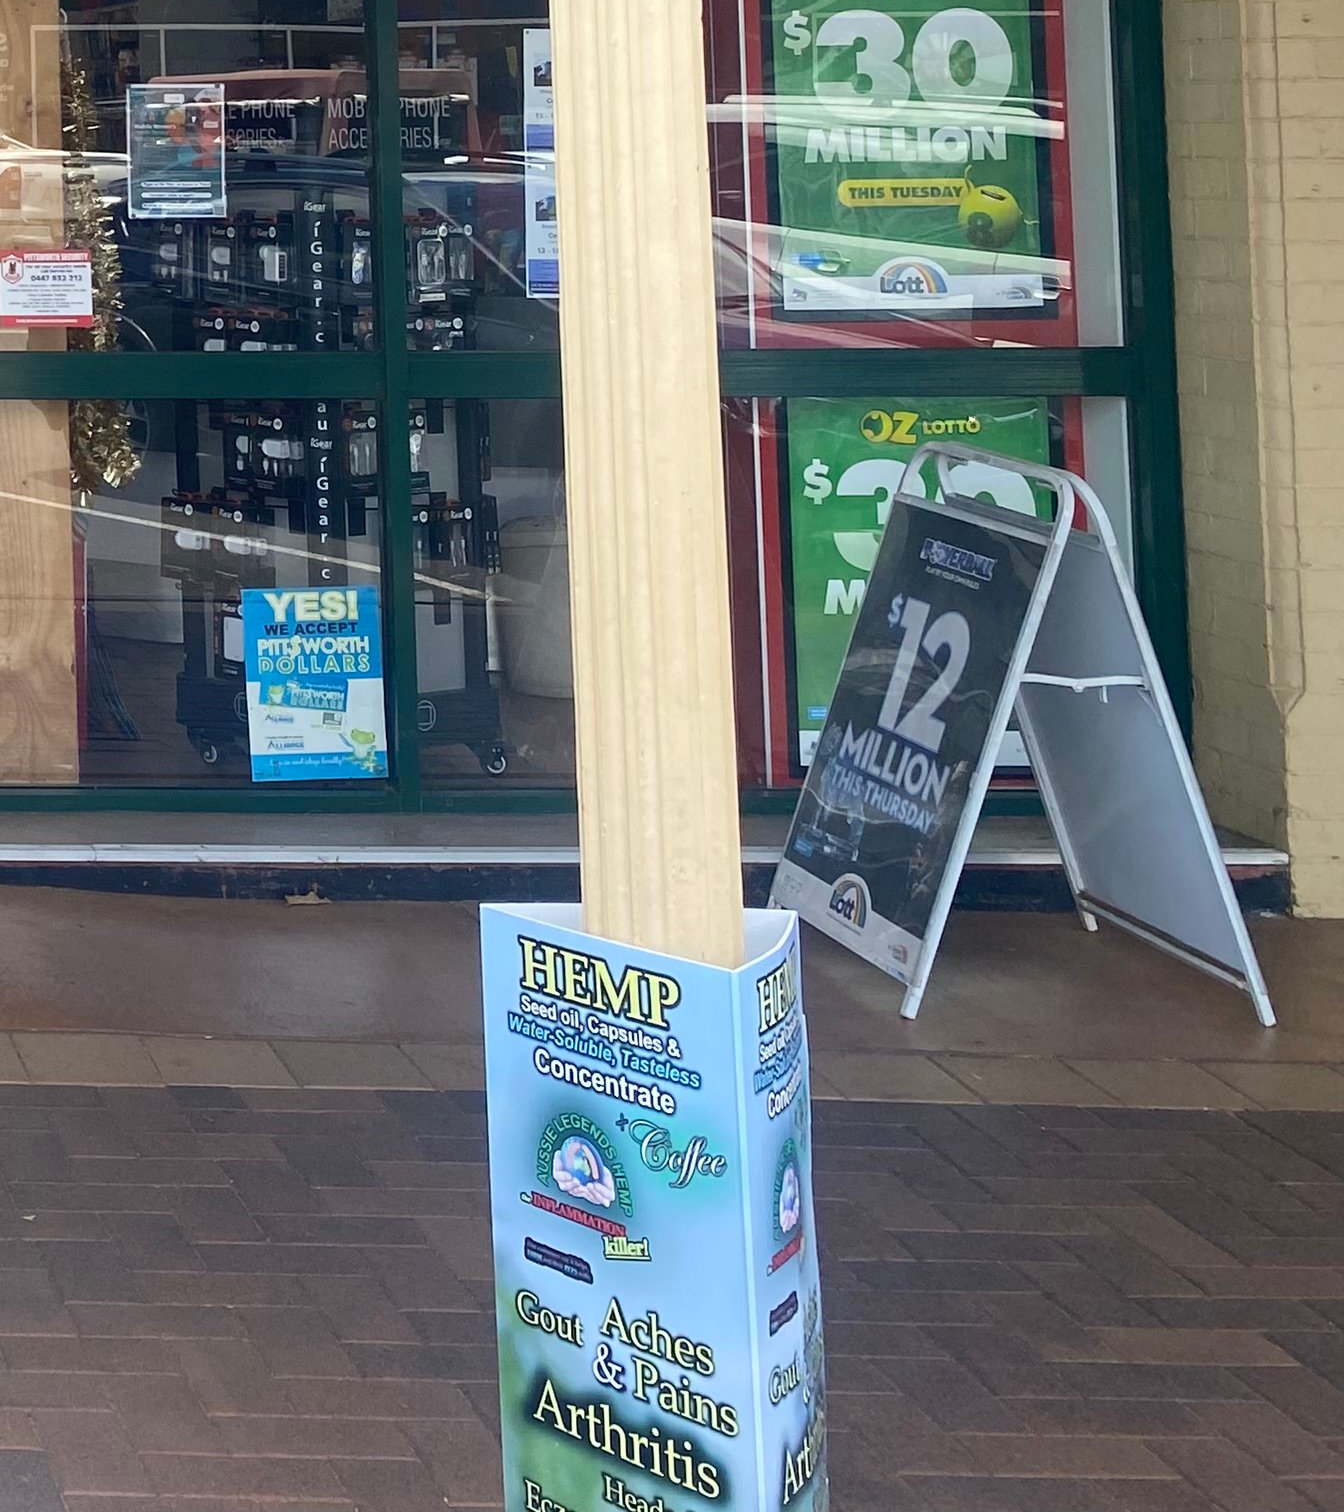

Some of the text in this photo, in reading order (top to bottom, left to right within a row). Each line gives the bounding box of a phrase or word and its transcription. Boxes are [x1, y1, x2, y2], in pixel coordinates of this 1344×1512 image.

[783, 8, 1013, 126] $30
[241, 101, 296, 119] PHONE
[804, 126, 1007, 164] MILLION
[303, 201, 326, 212] iGear
[848, 186, 964, 199] THIS TUESDAY
[880, 277, 924, 295] Lott
[861, 410, 981, 445] OZ LOTTO
[263, 590, 359, 623] YES!
[264, 622, 358, 636] WE ACCEPT
[258, 653, 371, 675] DOLLARS
[877, 593, 970, 754] $12
[839, 720, 951, 807] MILLION
[831, 764, 936, 835] THIS THURSDAY
[829, 889, 855, 920] Lott
[518, 935, 681, 1030] HEMP
[508, 1013, 616, 1066] Water-Soluble,
[621, 1048, 701, 1089] Tasteless
[520, 995, 681, 1058] Seed oil, Capsules &
[533, 1047, 676, 1115] Concentrate
[536, 1114, 633, 1218] AUSSIE LEGENDS HEMP
[629, 1119, 727, 1188] Coffee
[531, 1190, 627, 1238] INFLAMMATION
[602, 1236, 652, 1262] killer!
[516, 1290, 584, 1346] Gout
[600, 1297, 714, 1377] Aches
[593, 1343, 740, 1437] & Pains
[533, 1379, 721, 1500] Arthritis
